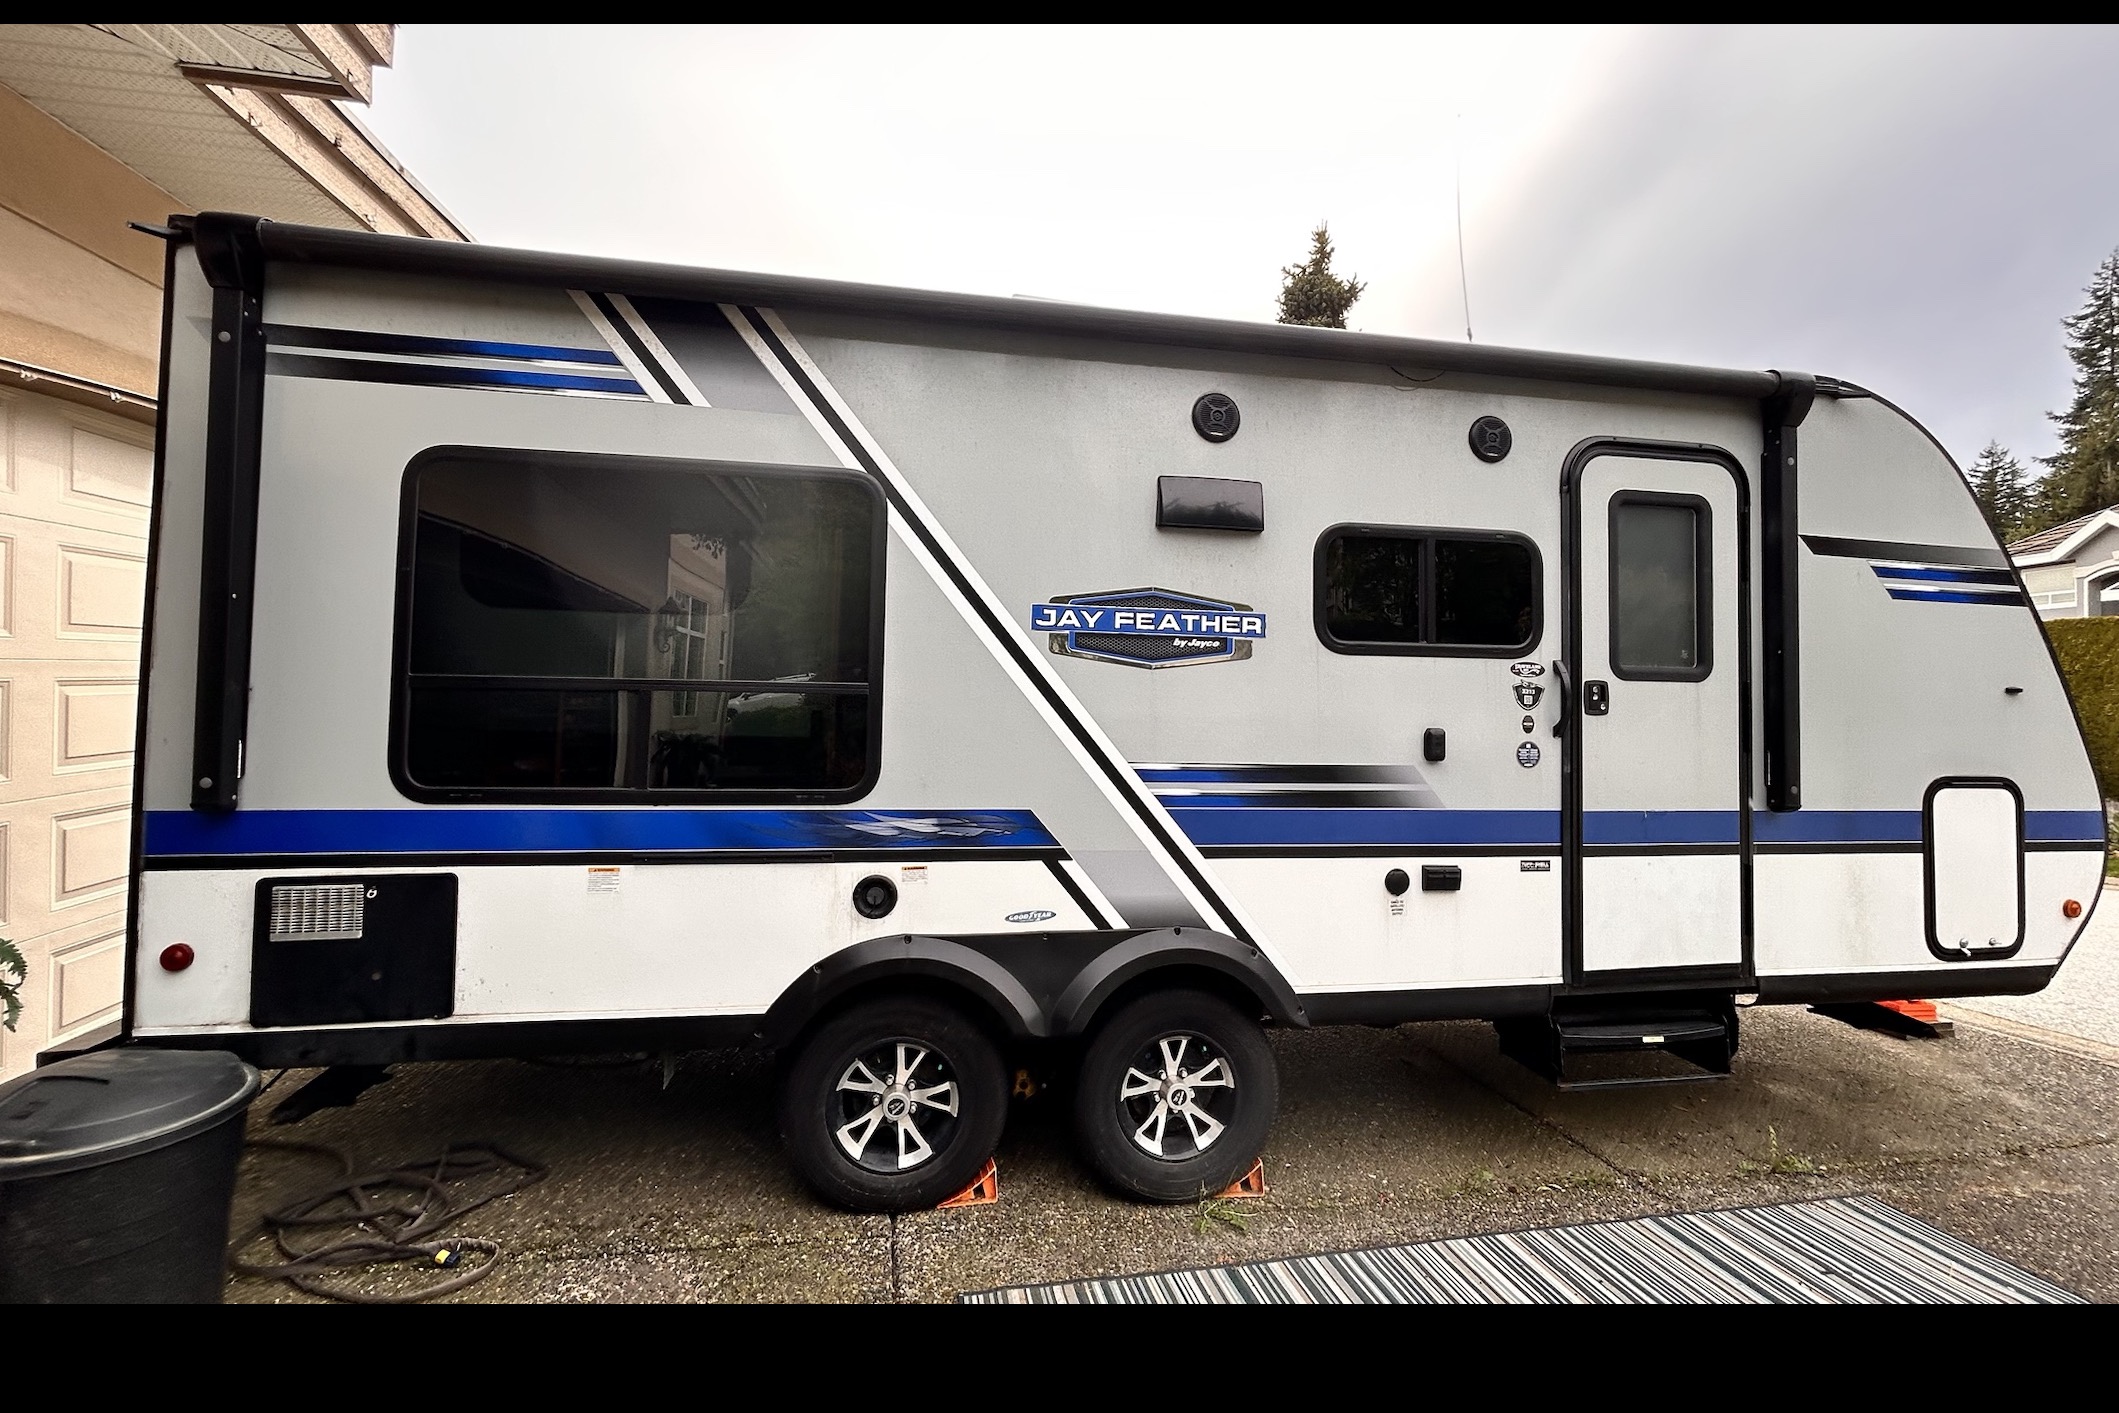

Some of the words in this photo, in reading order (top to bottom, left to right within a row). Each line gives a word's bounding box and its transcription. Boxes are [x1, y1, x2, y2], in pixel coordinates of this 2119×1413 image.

[1035, 608, 1103, 627] JAY
[1114, 611, 1263, 634] FEATHER
[1173, 637, 1188, 648] by
[1187, 638, 1220, 649] Jayco
[1008, 911, 1052, 920] GOODYEAR
